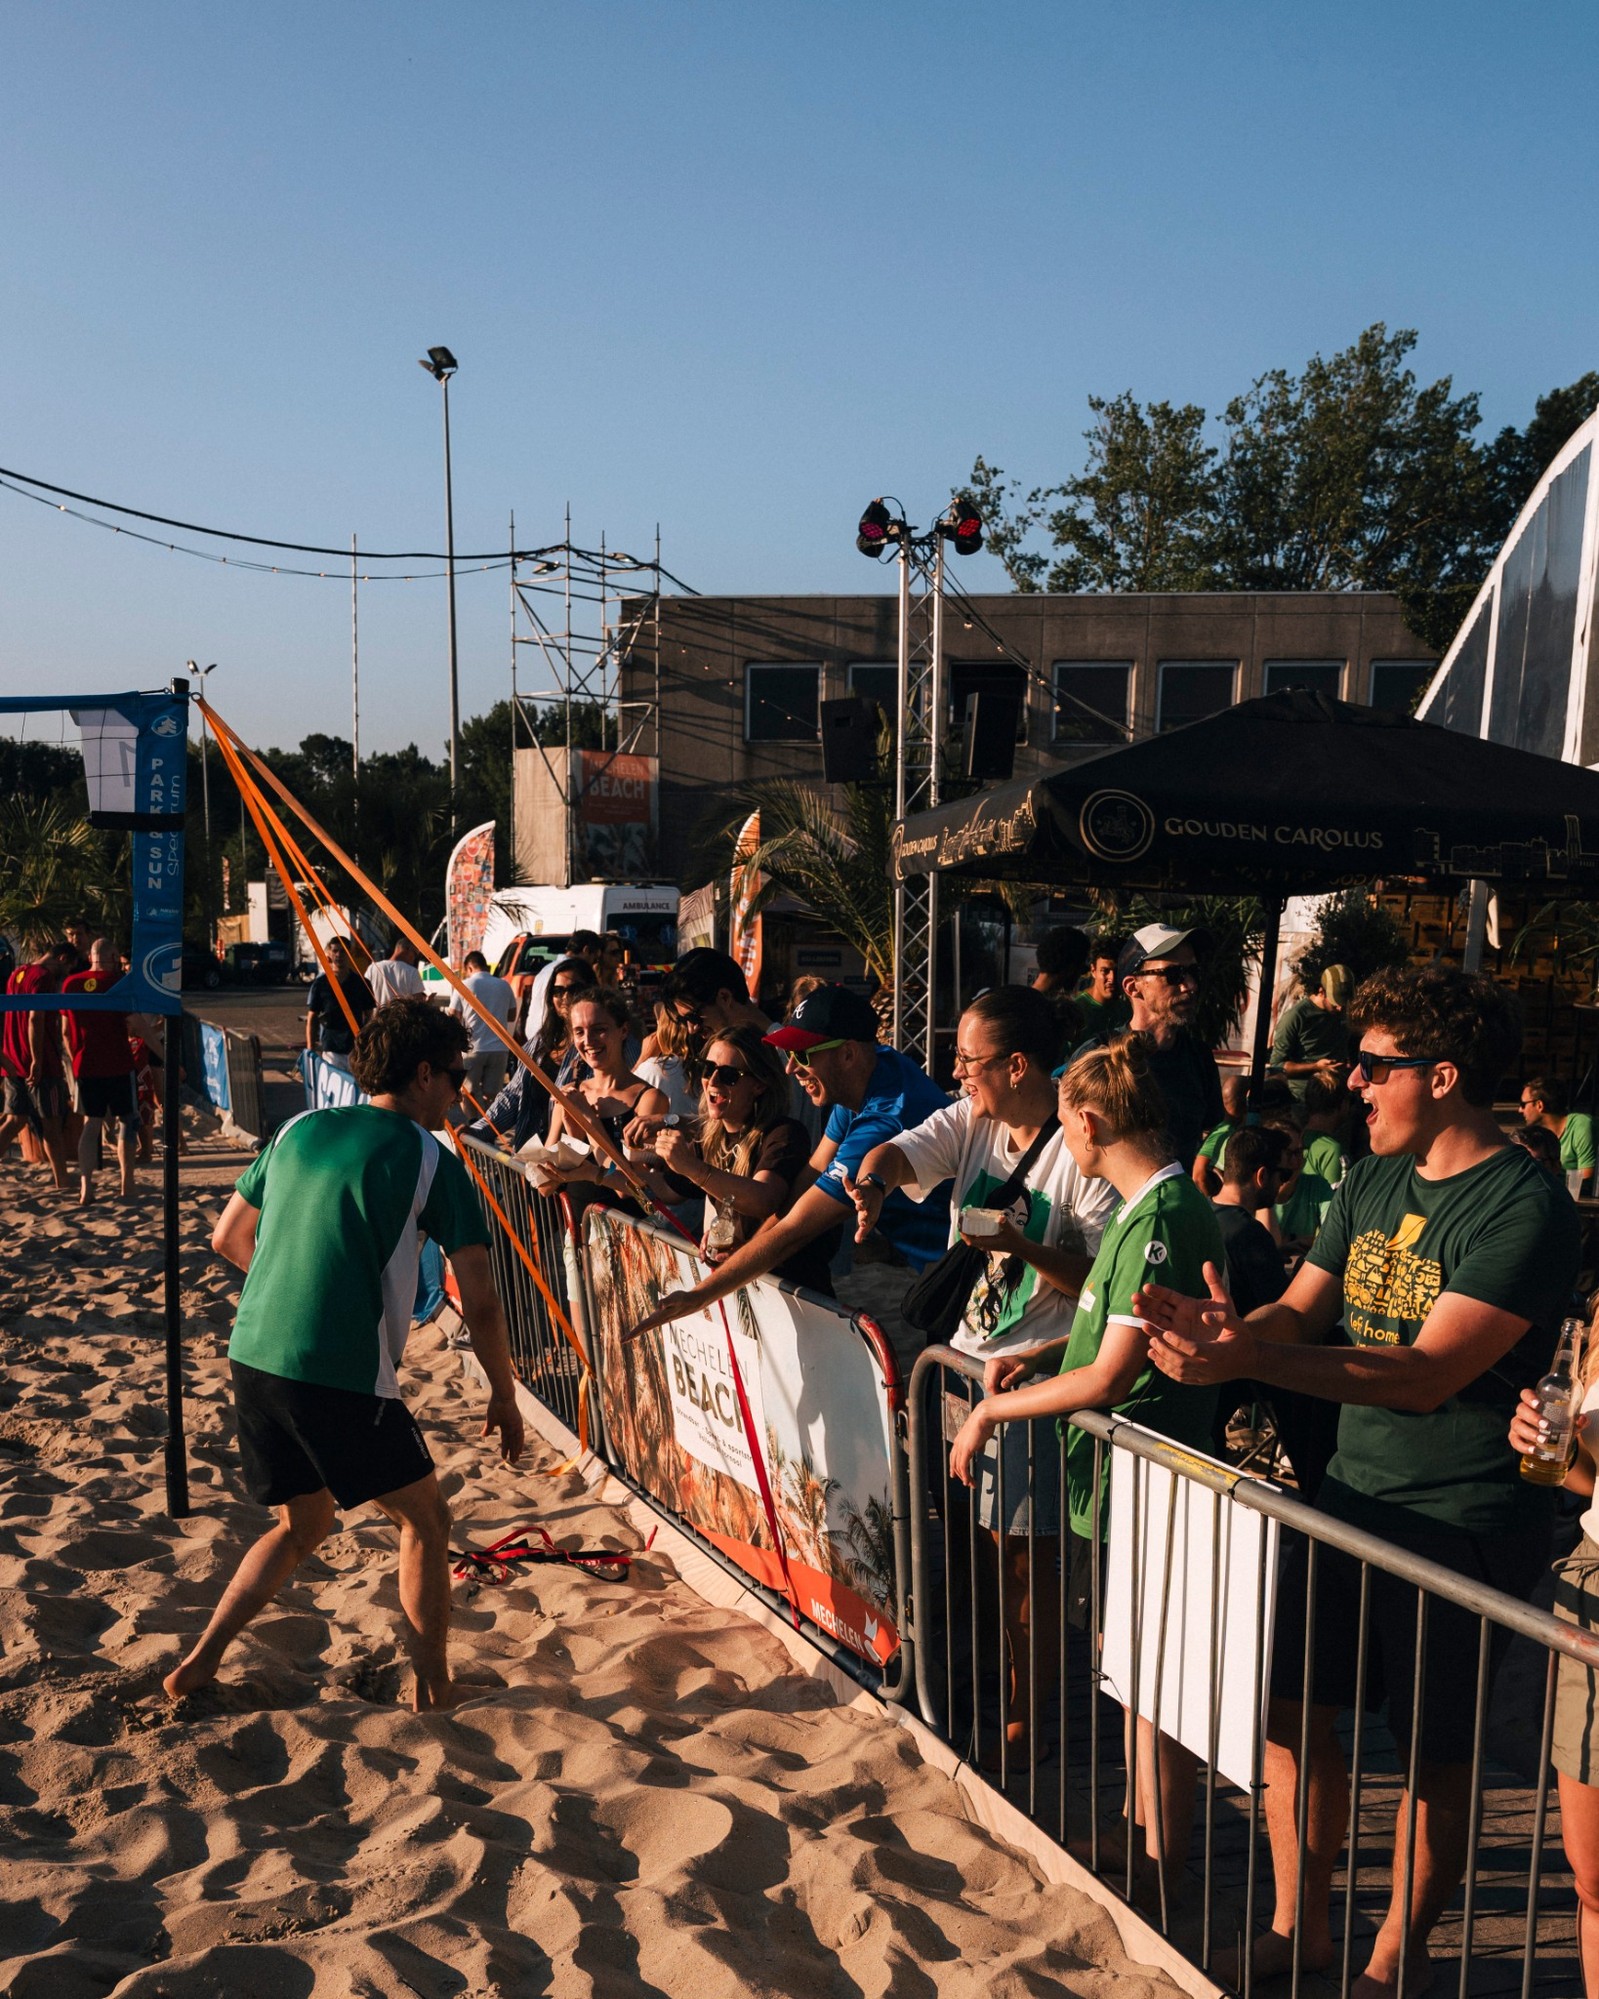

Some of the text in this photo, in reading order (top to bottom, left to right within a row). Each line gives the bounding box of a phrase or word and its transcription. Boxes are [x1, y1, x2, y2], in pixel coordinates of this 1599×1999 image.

[150, 758, 164, 814] PARK
[589, 775, 645, 799] BEACH
[167, 775, 181, 877] Specrum
[1164, 817, 1384, 851] GOUDEN CAROLUS
[148, 847, 162, 890] SUN
[623, 902, 670, 911] AMBULANCE
[668, 1319, 749, 1386] MECHELEN
[1363, 1320, 1400, 1345] home
[811, 1597, 865, 1654] MECHELEN
